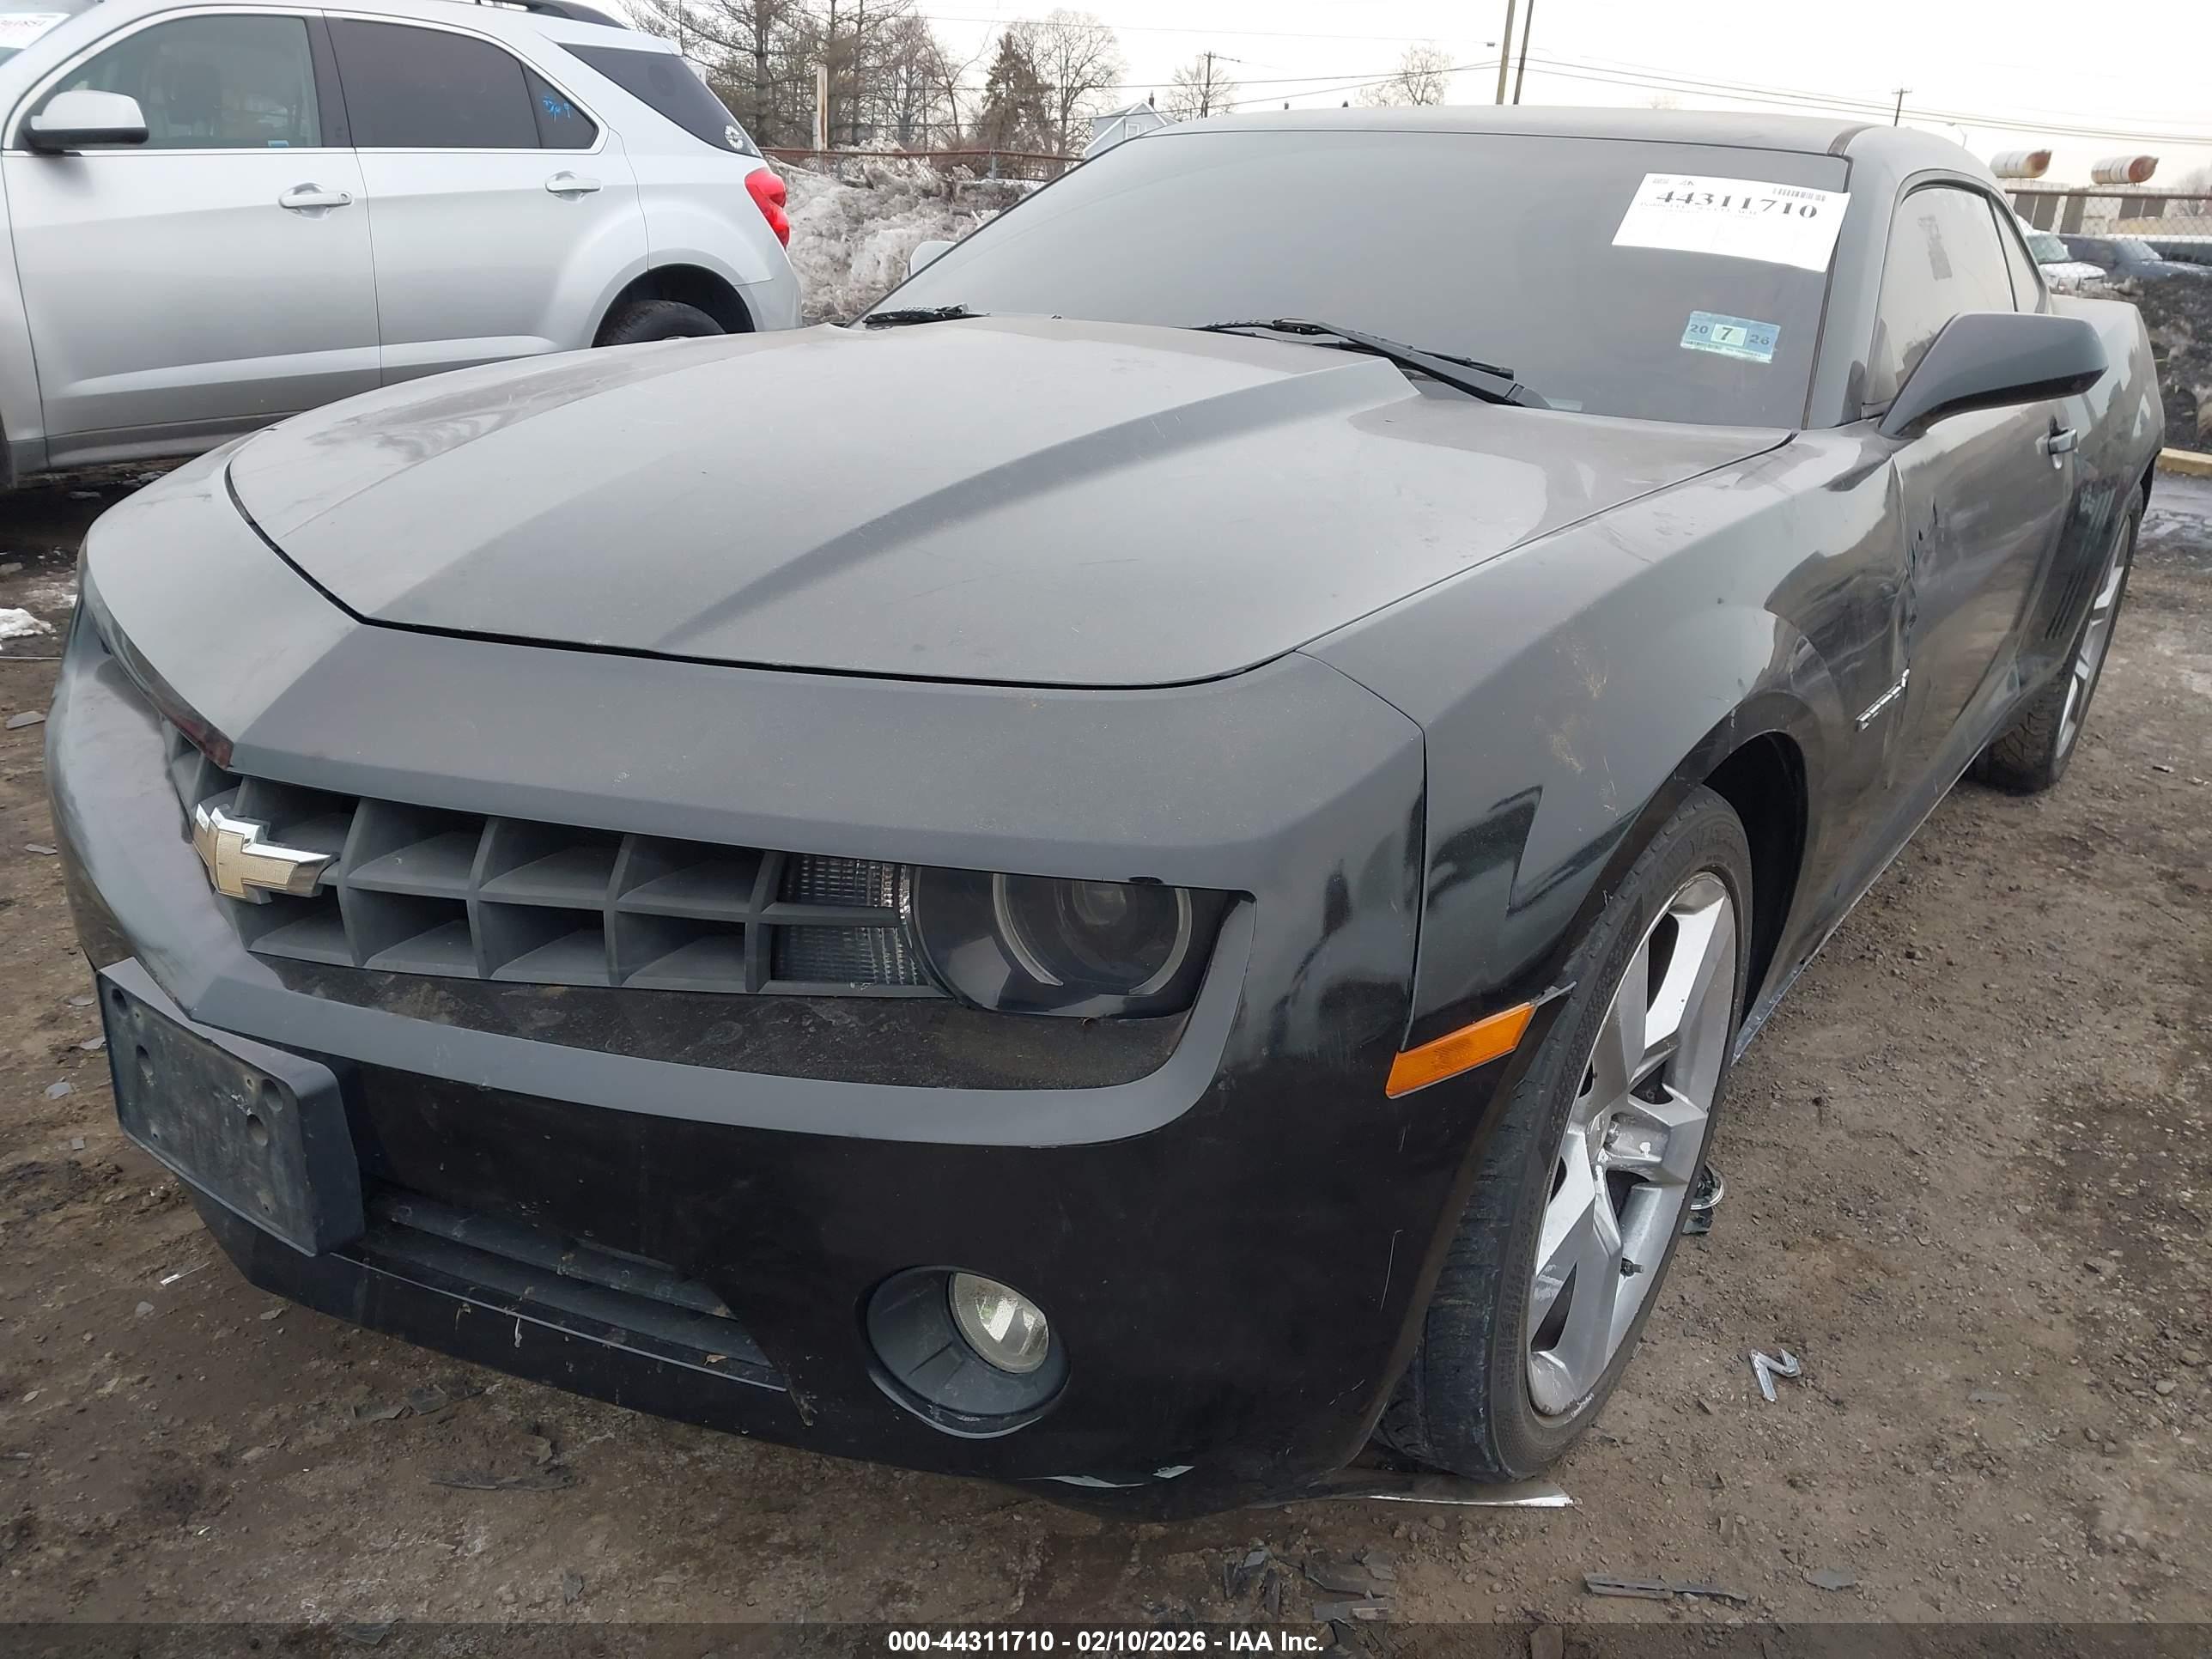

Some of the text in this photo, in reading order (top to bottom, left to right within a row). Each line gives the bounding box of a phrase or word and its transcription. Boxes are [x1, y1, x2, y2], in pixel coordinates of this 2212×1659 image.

[1656, 191, 1818, 219] 44311710
[1690, 324, 1770, 345] 20 7 26
